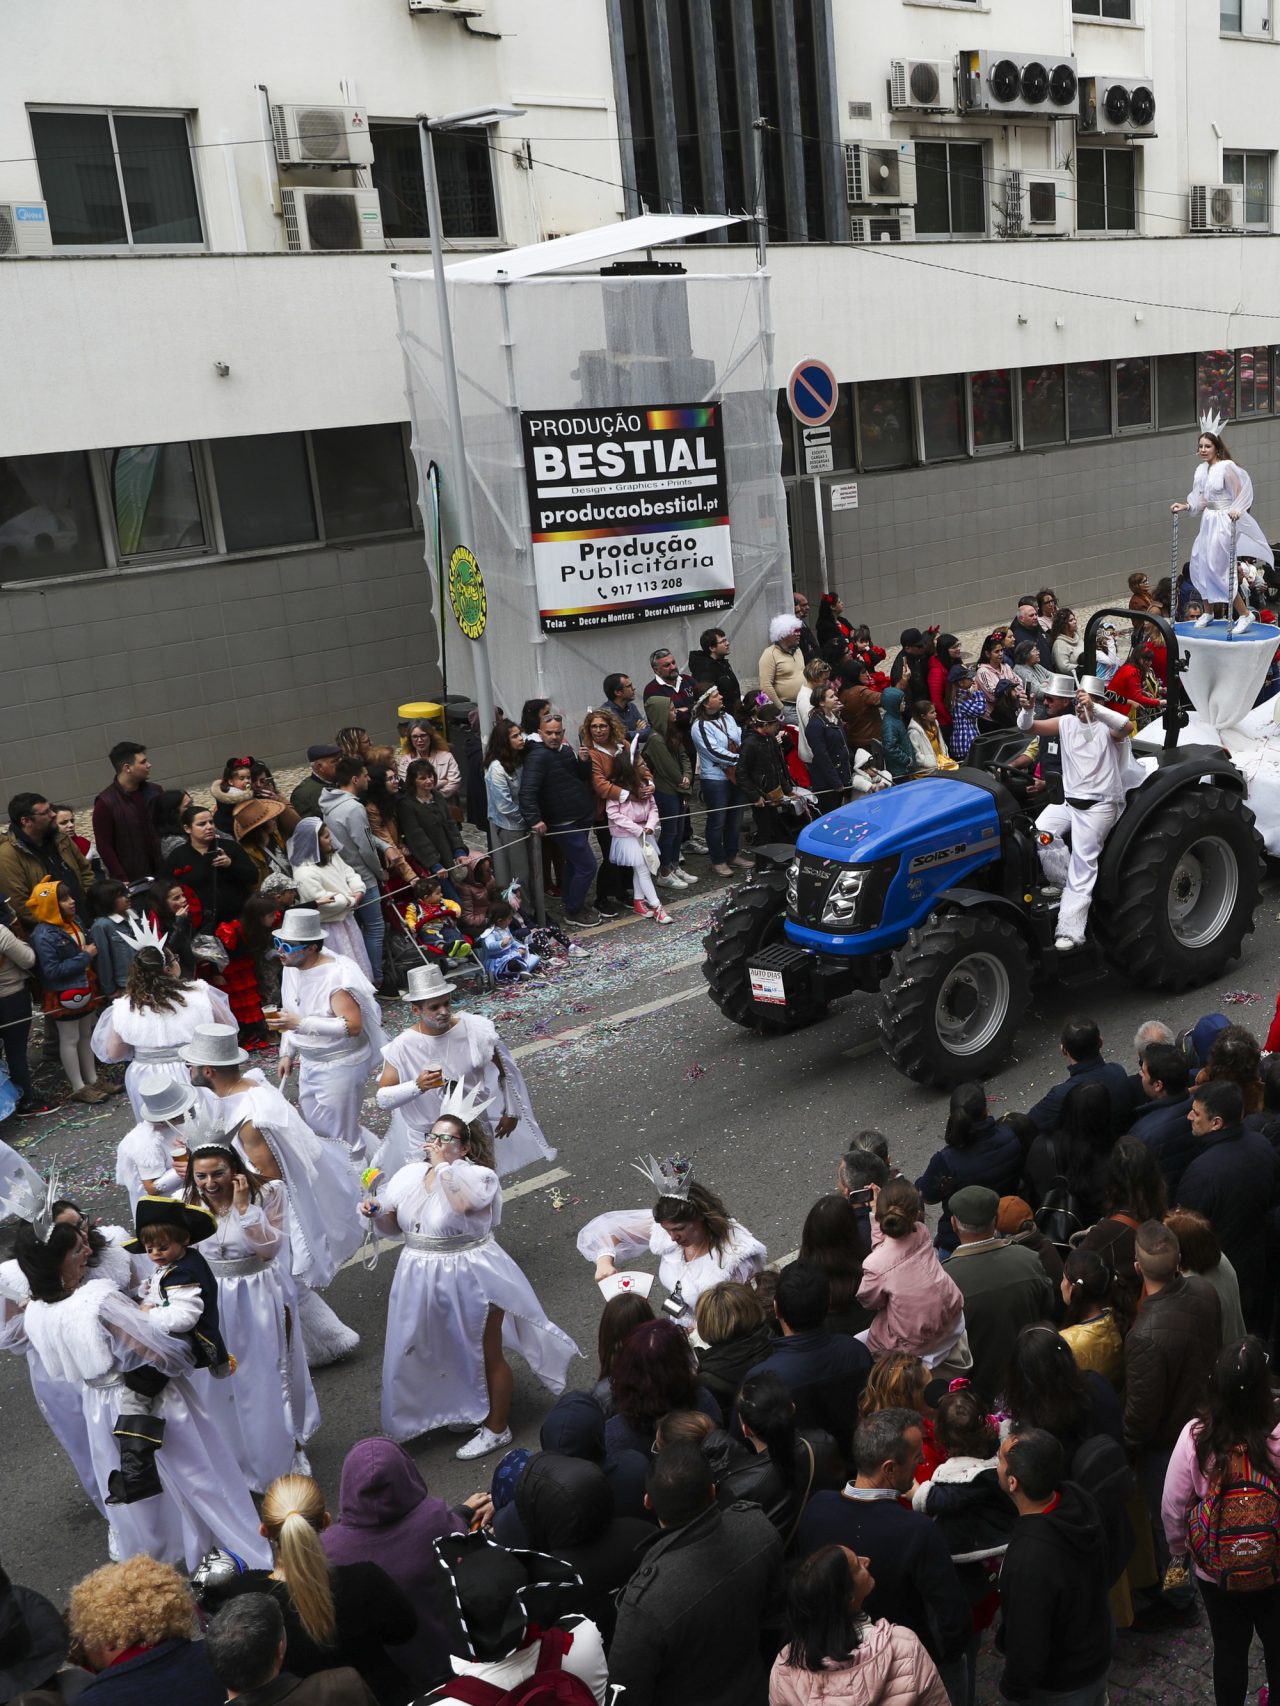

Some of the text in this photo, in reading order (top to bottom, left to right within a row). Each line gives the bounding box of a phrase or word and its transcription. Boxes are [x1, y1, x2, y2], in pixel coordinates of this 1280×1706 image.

[530, 413, 641, 437] PRODUÇÃO
[533, 437, 717, 480] BESTIAL
[571, 479, 693, 494] Design Graphics Prints
[540, 493, 719, 528] producaobestial.pt
[580, 534, 697, 561] Produção
[561, 553, 714, 582] Publicitária
[611, 578, 683, 596] 917 113 208
[546, 620, 567, 628] Telas
[579, 617, 600, 626] Decor
[608, 613, 635, 622] Montras
[645, 609, 662, 617] Decor
[669, 603, 695, 614] Viaturas
[751, 970, 766, 978] AUTO
